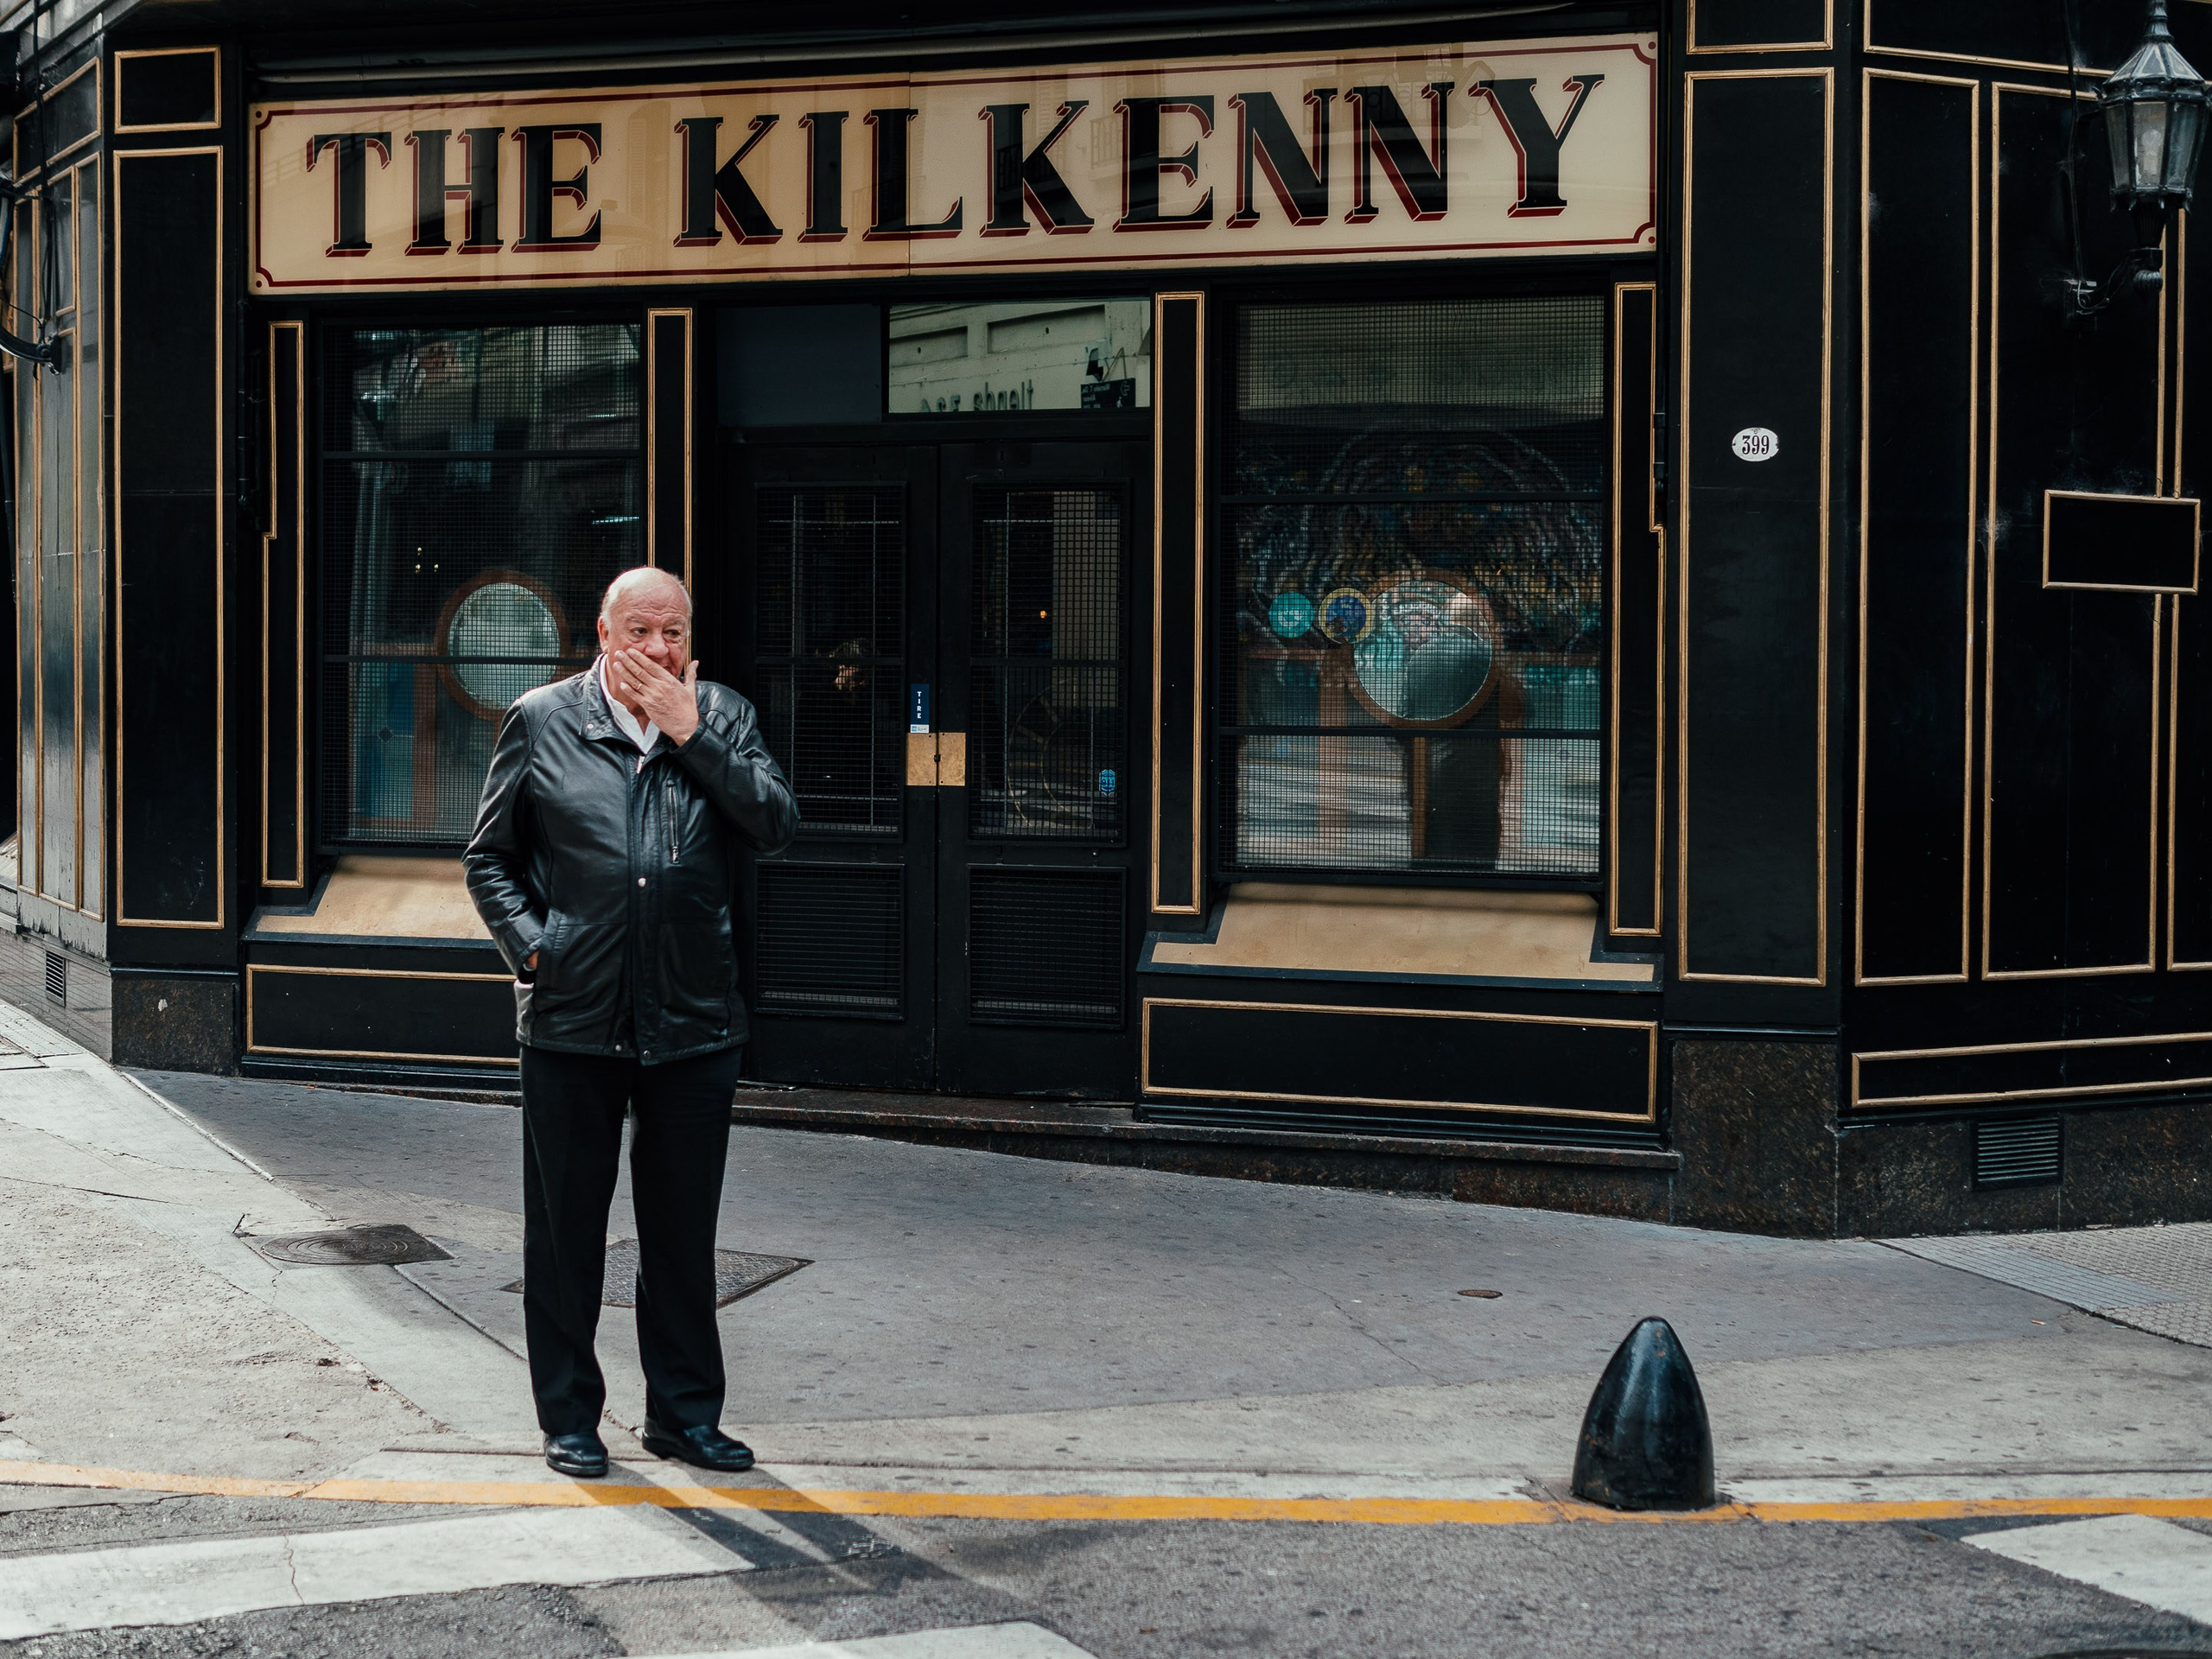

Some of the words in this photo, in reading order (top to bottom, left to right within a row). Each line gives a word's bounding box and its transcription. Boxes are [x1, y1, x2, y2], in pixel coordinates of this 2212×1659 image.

[306, 121, 603, 258] THE
[672, 73, 1605, 248] KILKENNY
[1741, 435, 1770, 455] 399
